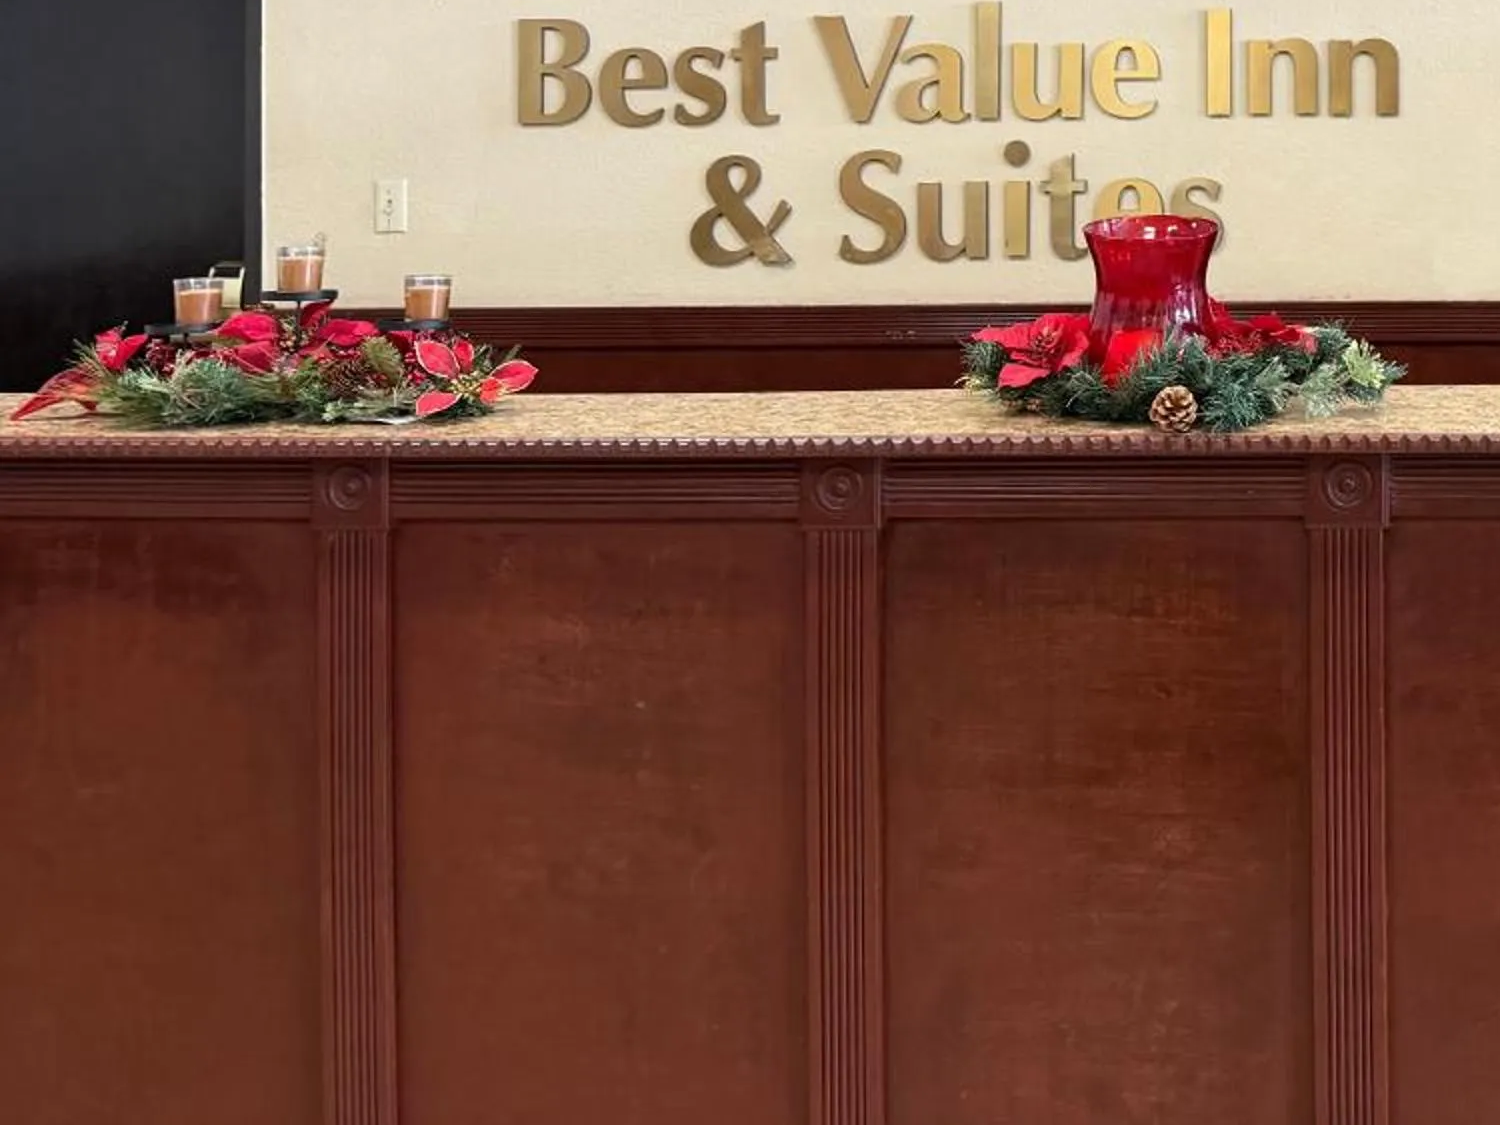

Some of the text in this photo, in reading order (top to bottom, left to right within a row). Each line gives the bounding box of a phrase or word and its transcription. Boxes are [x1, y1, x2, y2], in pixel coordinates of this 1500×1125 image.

[516, 1, 1401, 128] Best Value Inn
[689, 153, 796, 268] &
